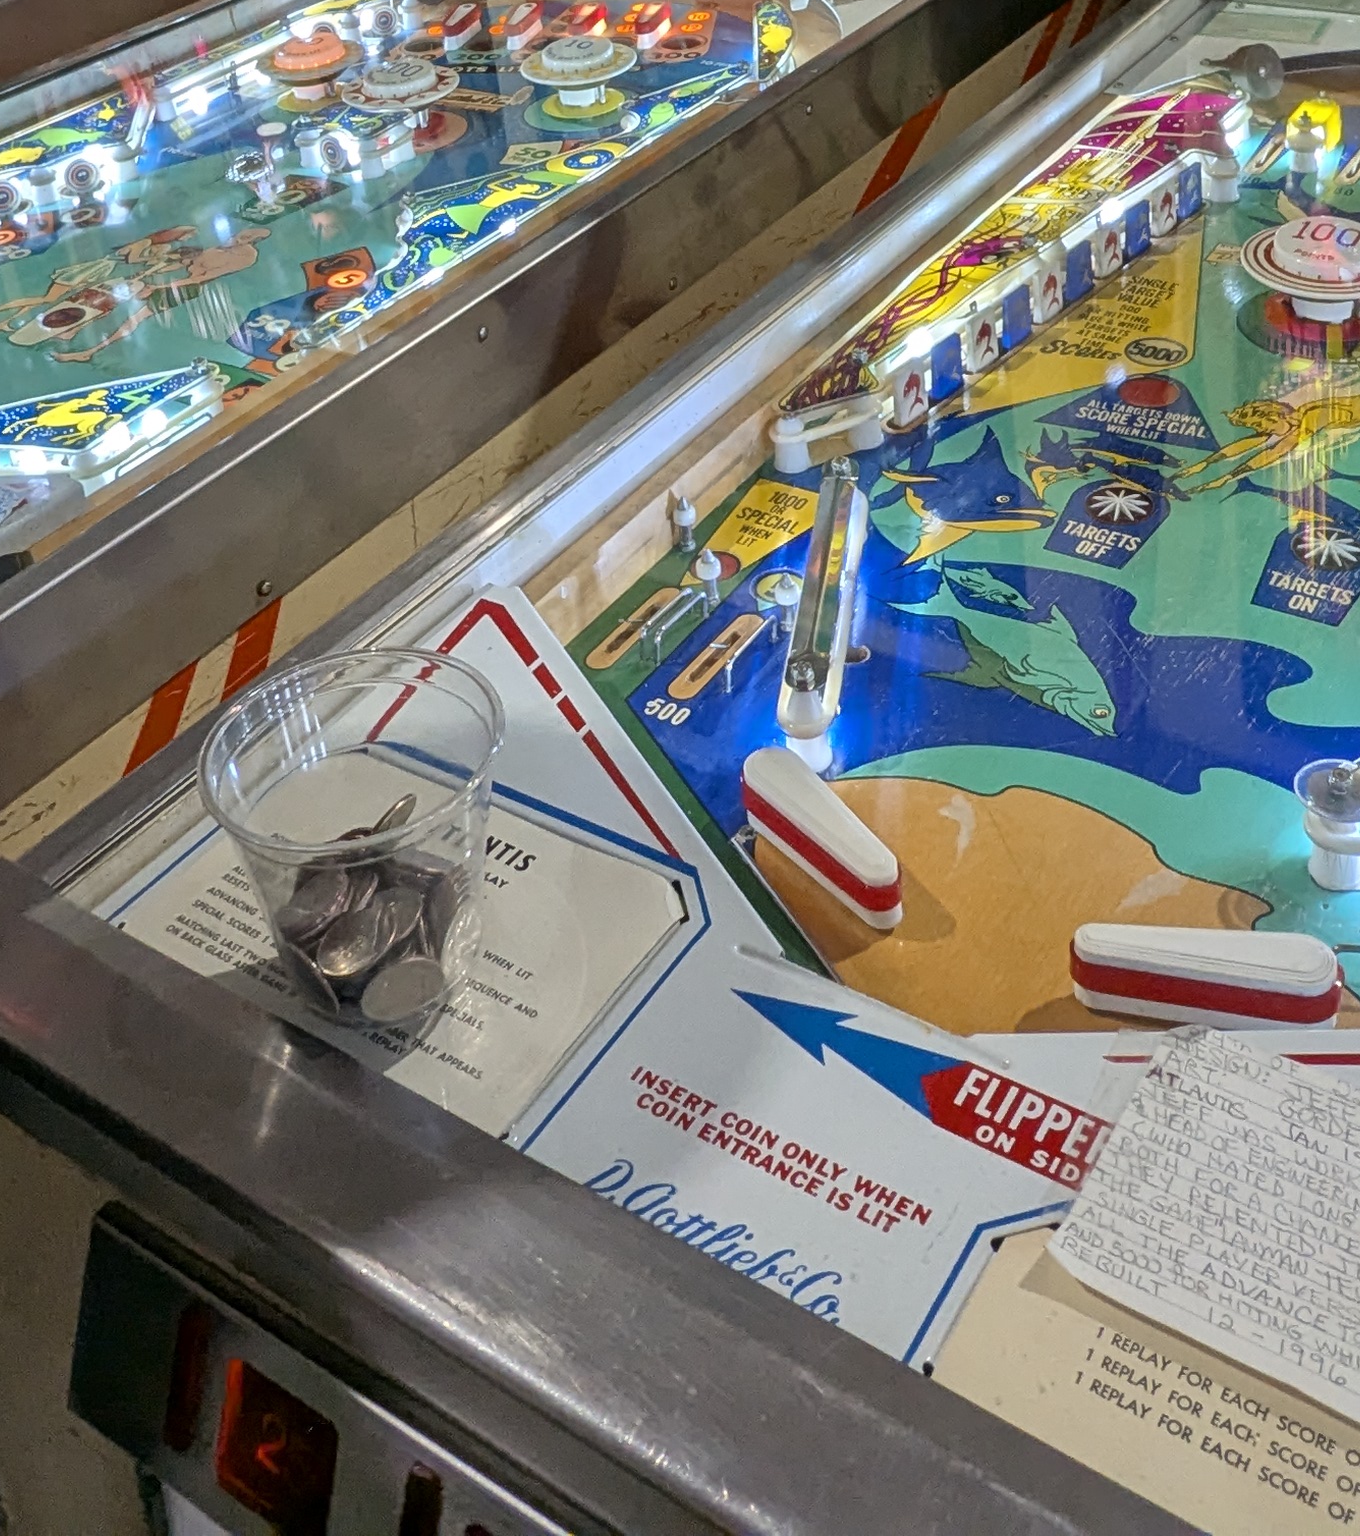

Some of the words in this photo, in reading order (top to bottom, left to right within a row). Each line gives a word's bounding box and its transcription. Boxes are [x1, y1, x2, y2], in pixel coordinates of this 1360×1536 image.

[1124, 284, 1176, 301] ARGET
[1127, 275, 1181, 292] SINGLE
[1117, 293, 1162, 310] VALUE
[1040, 339, 1122, 361] SCORES
[1127, 341, 1184, 364] 5000
[1075, 406, 1134, 426] SCORE
[1133, 415, 1207, 439] SPECIAL
[1087, 399, 1108, 410] ALL
[1111, 403, 1164, 418] TARGETS
[1164, 411, 1202, 424] DOWN
[1105, 424, 1141, 438] WHEN
[1141, 430, 1162, 441] LIT
[767, 490, 810, 511] 1000
[769, 502, 788, 516] OR
[735, 506, 801, 536] SPECIAL
[738, 524, 774, 542] WHEN
[1062, 519, 1142, 552] TARGETS
[735, 534, 757, 547] LIT
[1075, 539, 1113, 559] OFF
[1267, 569, 1357, 607] TARGETS
[1288, 595, 1321, 615] ON
[643, 697, 692, 727] 500
[206, 886, 260, 917] ADVANCING
[191, 898, 225, 921] SPECIAL
[226, 916, 262, 940] SCORES
[165, 923, 182, 936] ON
[179, 931, 207, 949] BACK
[204, 944, 235, 964] GLASS
[175, 913, 222, 943] MATCHING
[219, 936, 245, 954] LAST
[244, 948, 269, 966] TWO
[482, 948, 514, 972] WHEN
[514, 965, 535, 982] LIT
[513, 1001, 539, 1020] AND
[411, 1033, 439, 1056] THAT
[439, 1050, 484, 1081] APPEARS
[630, 1065, 719, 1118] INSERT
[720, 1110, 781, 1150] COIN
[781, 1141, 849, 1183] ONLY
[853, 1174, 934, 1227] WHEN
[974, 1123, 1018, 1154] ON
[1028, 1149, 1082, 1185] SID
[636, 1092, 697, 1132] COIN
[697, 1122, 826, 1198] ENTRANCE
[825, 1186, 855, 1213] IS
[856, 1202, 903, 1234] LIT
[622, 1182, 796, 1283] Gottlieb
[1060, 1235, 1168, 1297] REBUILT
[1208, 1305, 1237, 1331] 12
[1278, 1338, 1348, 1386] 1996
[1110, 1333, 1173, 1372] REPLAY
[1176, 1365, 1214, 1396] FOR
[1219, 1386, 1271, 1423] EACH
[1276, 1415, 1338, 1457] SCORE
[1100, 1356, 1164, 1396] REPLAY
[1166, 1389, 1205, 1419] FOR
[1209, 1410, 1263, 1447] EACH
[1266, 1440, 1329, 1483] SCORE
[1089, 1378, 1153, 1422] REPLAY
[1156, 1412, 1194, 1444] FOR
[1199, 1435, 1253, 1474] EACH
[1257, 1465, 1321, 1510] SCORE
[1327, 1499, 1357, 1526] OF
